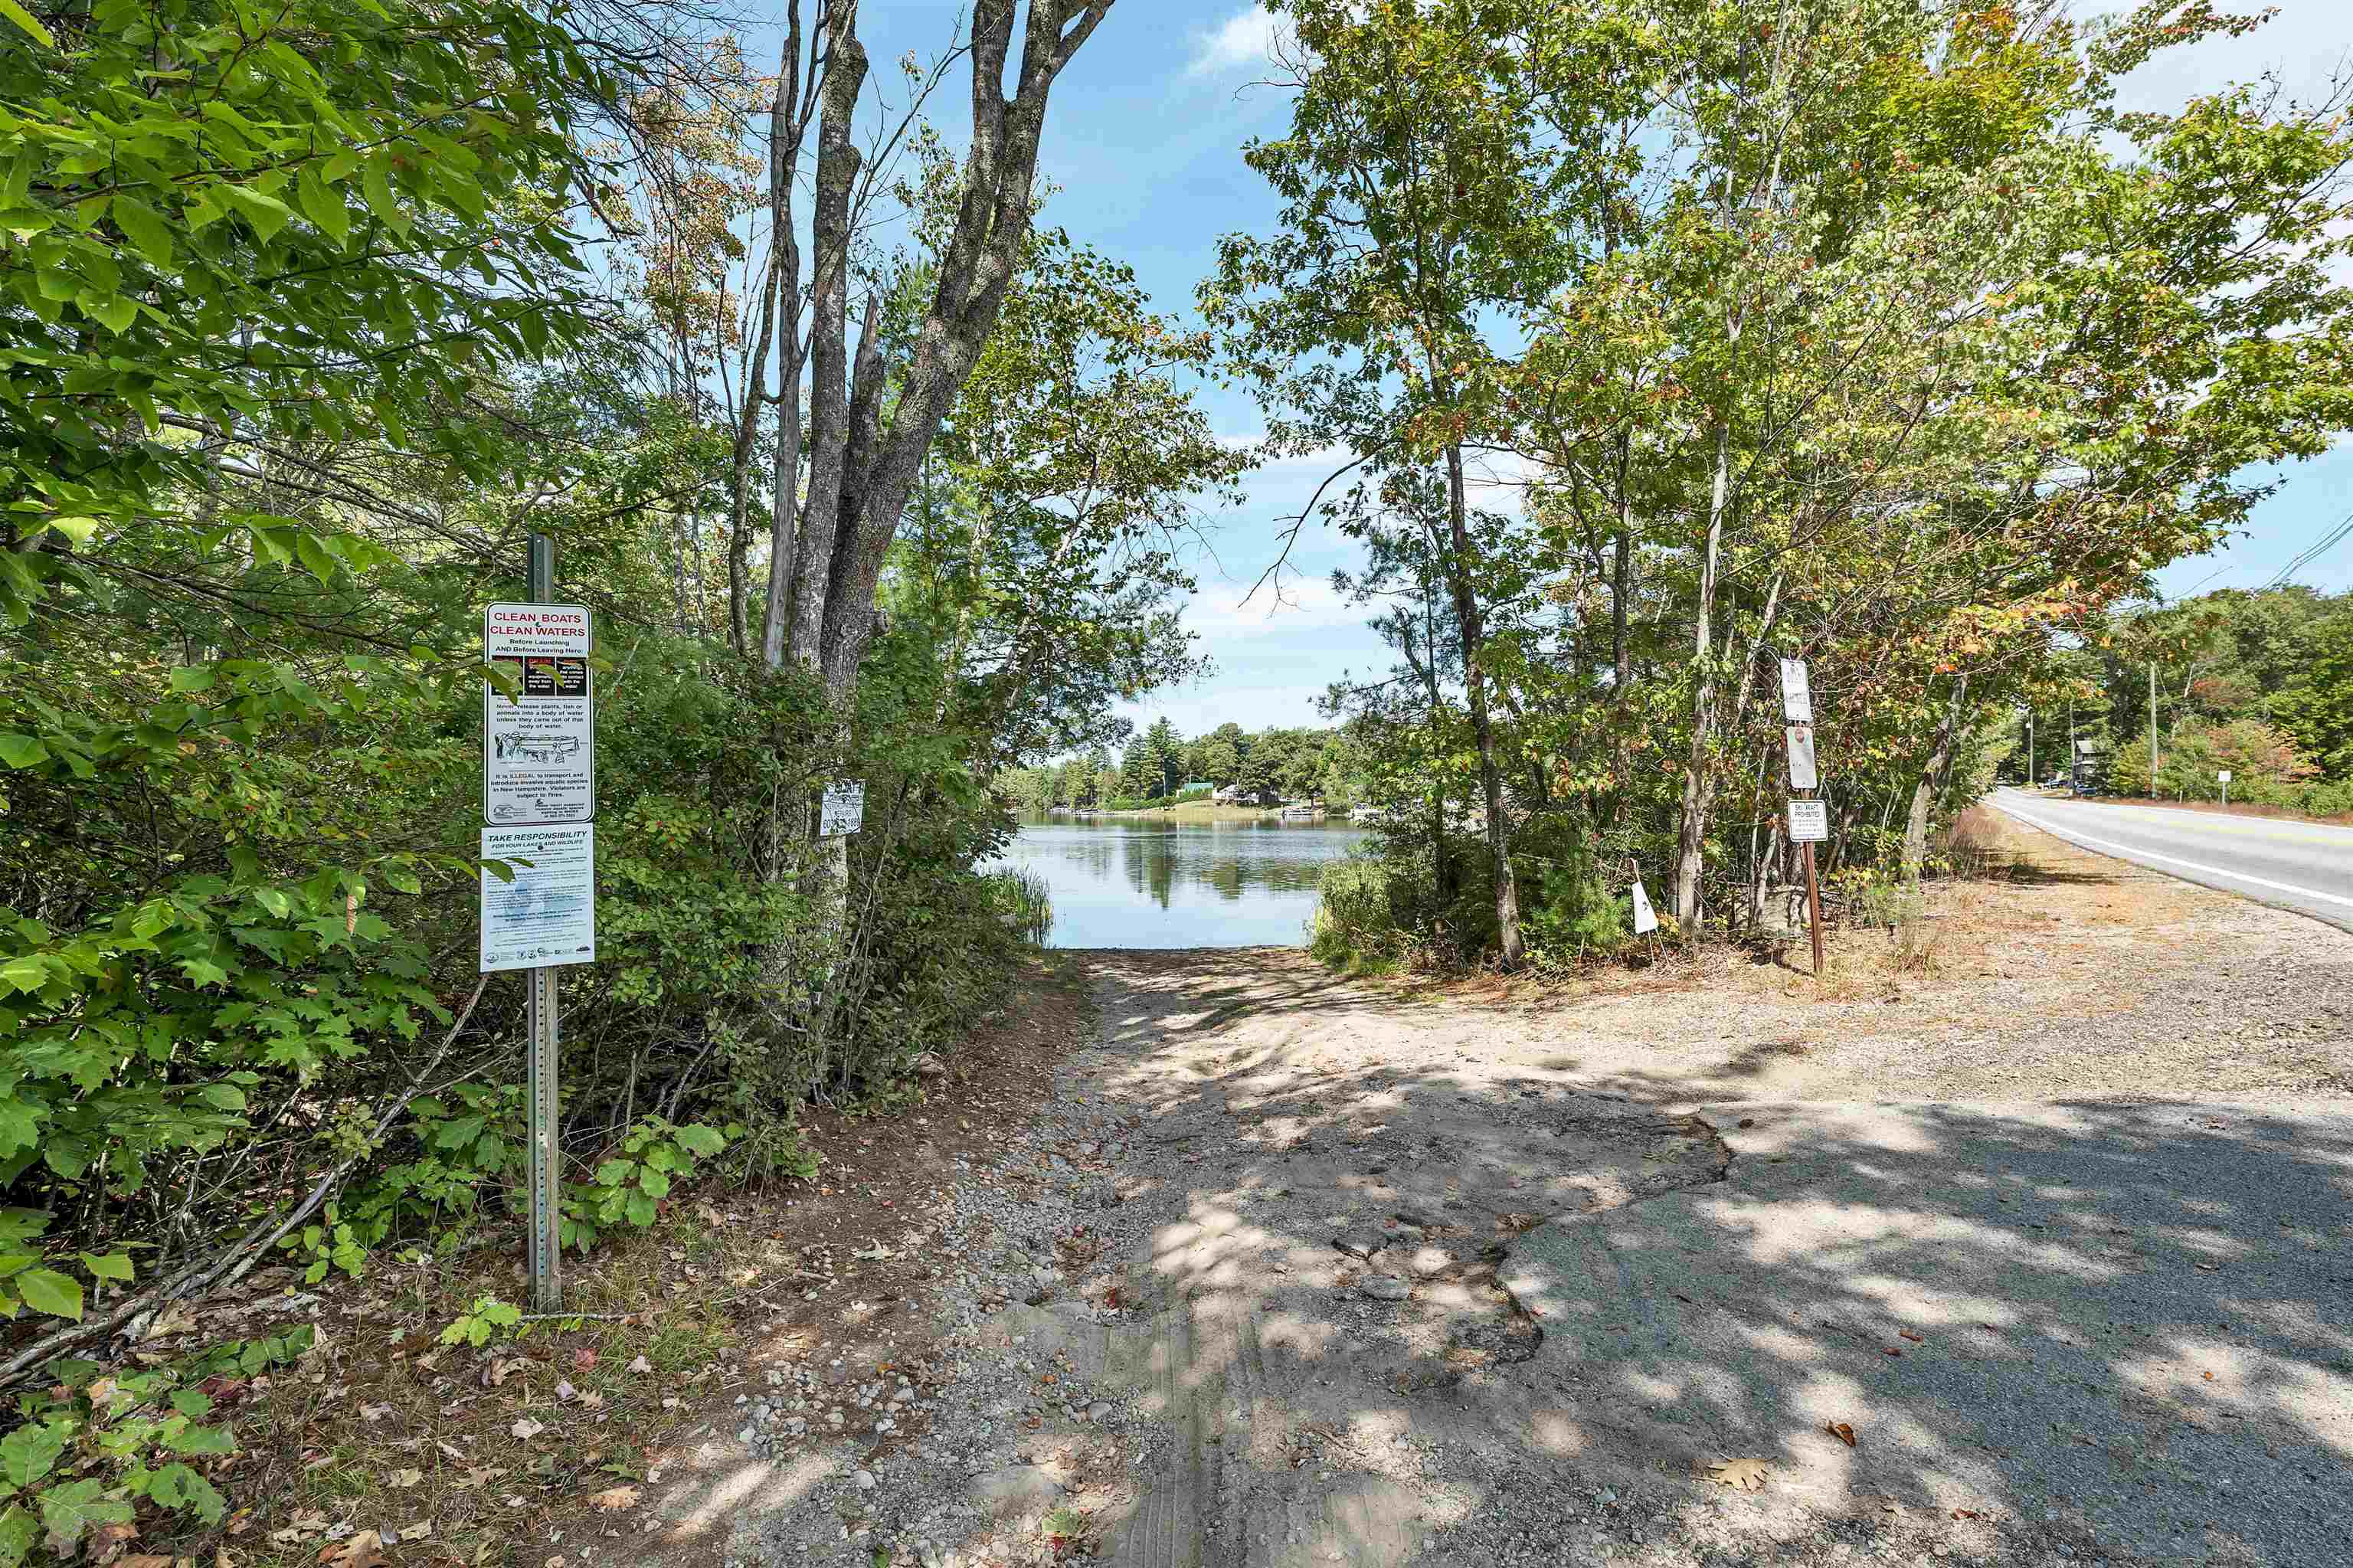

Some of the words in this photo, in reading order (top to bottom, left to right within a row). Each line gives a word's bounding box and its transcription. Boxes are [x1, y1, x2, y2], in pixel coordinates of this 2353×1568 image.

[494, 613, 535, 621] CLEAN
[542, 614, 581, 623] BOATS
[490, 626, 532, 635] CLEAN
[536, 627, 585, 637] WATERS
[513, 830, 587, 841] RESPONSIBILITY
